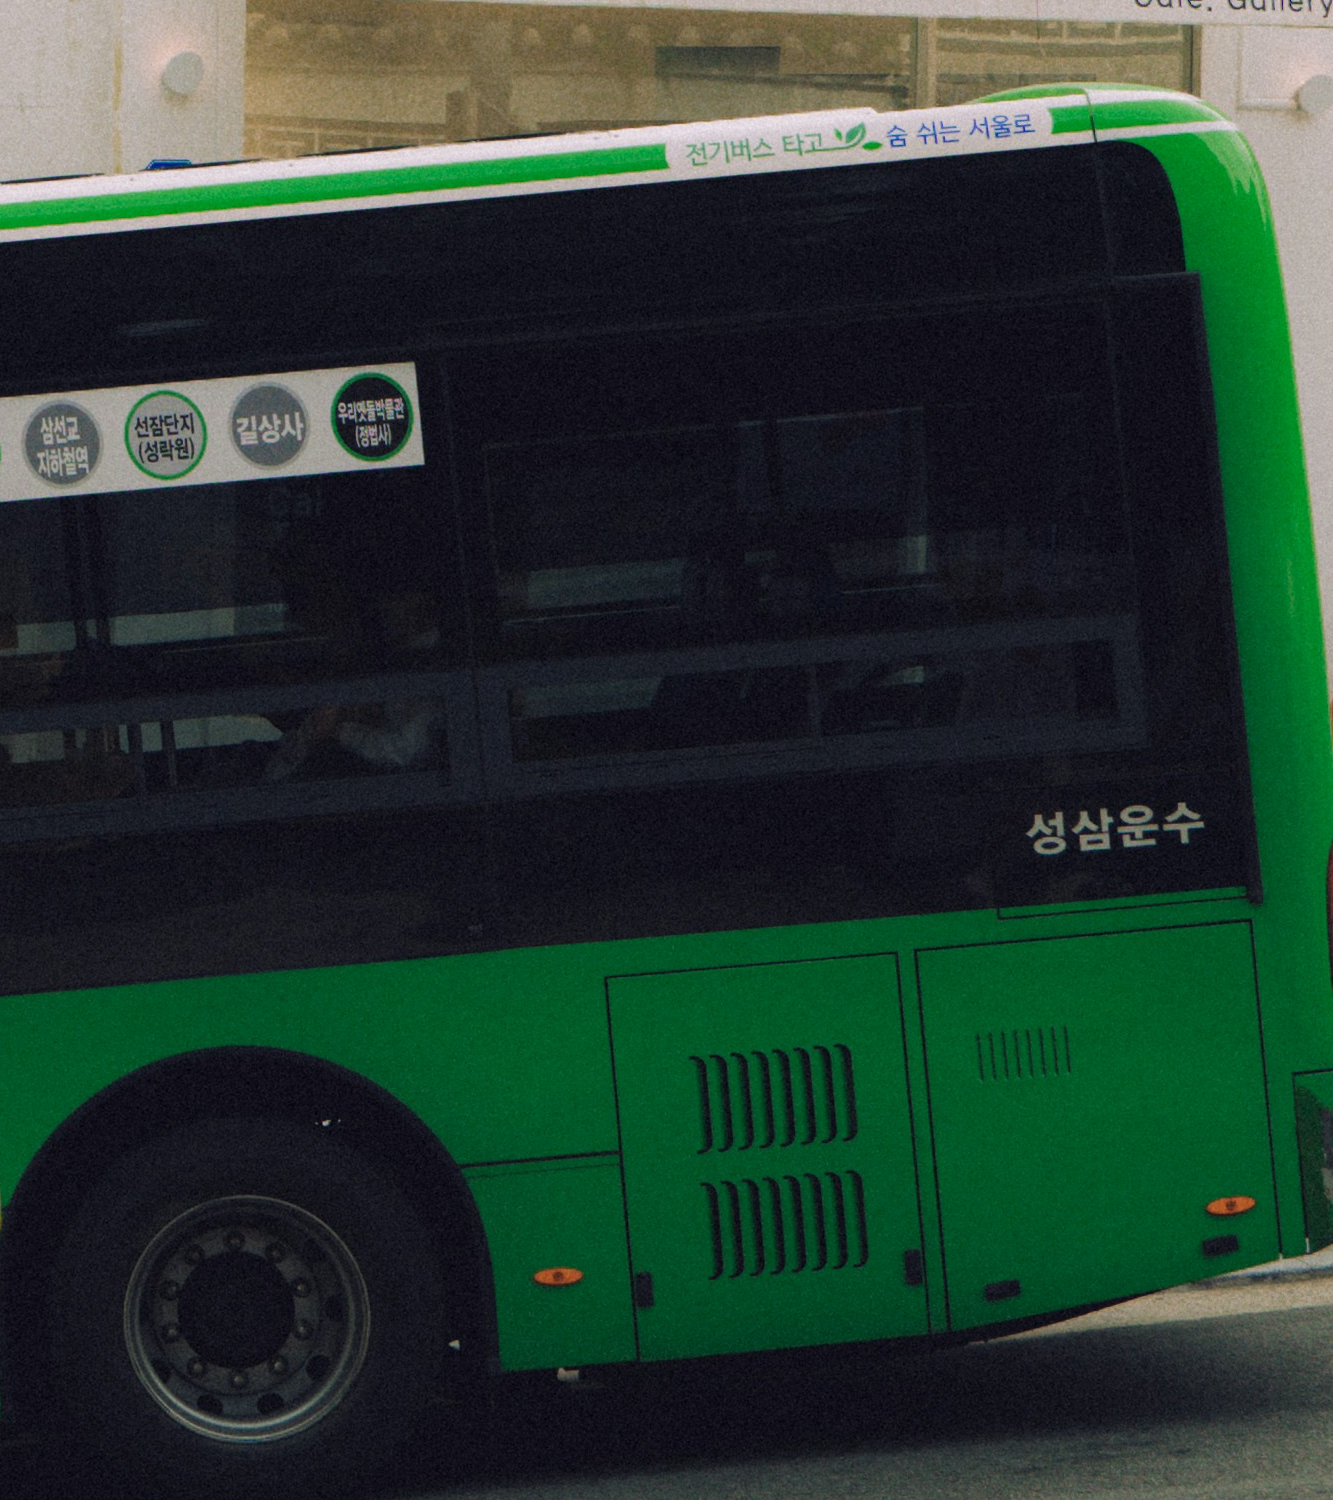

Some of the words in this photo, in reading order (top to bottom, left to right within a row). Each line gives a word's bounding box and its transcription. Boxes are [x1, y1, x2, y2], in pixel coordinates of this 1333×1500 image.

[685, 139, 773, 167] 전기버스
[784, 132, 825, 156] 타고
[886, 124, 907, 148] 숨
[918, 121, 962, 146] 쉬는
[970, 114, 1036, 140] 서울로
[40, 416, 80, 445] 삼선교
[134, 412, 195, 438] 선잠단지
[237, 411, 305, 446] 길상사
[355, 424, 393, 448] (정법사)
[36, 446, 90, 479] 지하철역
[138, 438, 195, 463] (성락원)
[1025, 800, 1205, 856] 성삼운수
